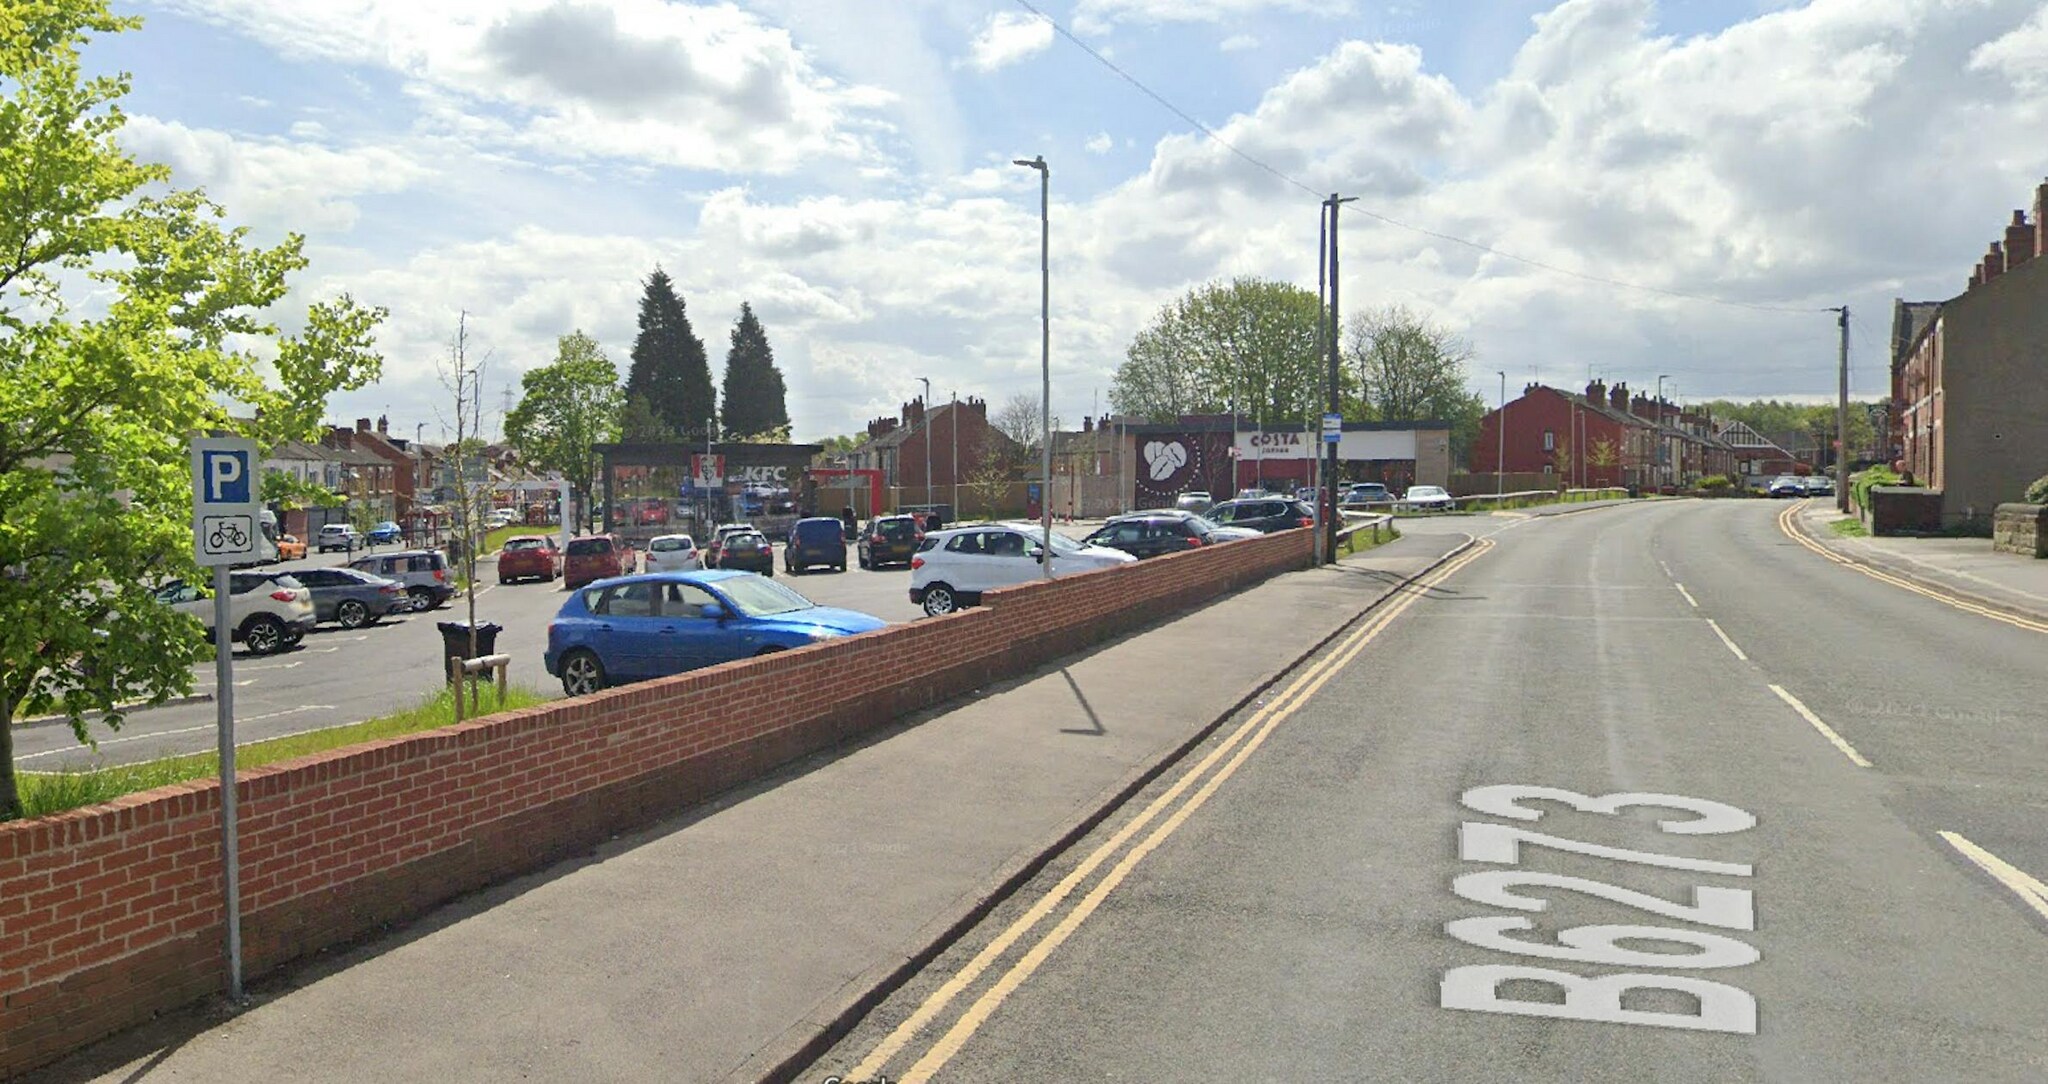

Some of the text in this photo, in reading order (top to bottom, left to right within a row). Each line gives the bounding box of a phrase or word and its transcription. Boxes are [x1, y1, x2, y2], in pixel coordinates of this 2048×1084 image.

[1250, 433, 1300, 446] COSTA
[210, 454, 241, 499] P
[743, 465, 787, 480] KFC
[1440, 783, 1760, 1035] B6273
